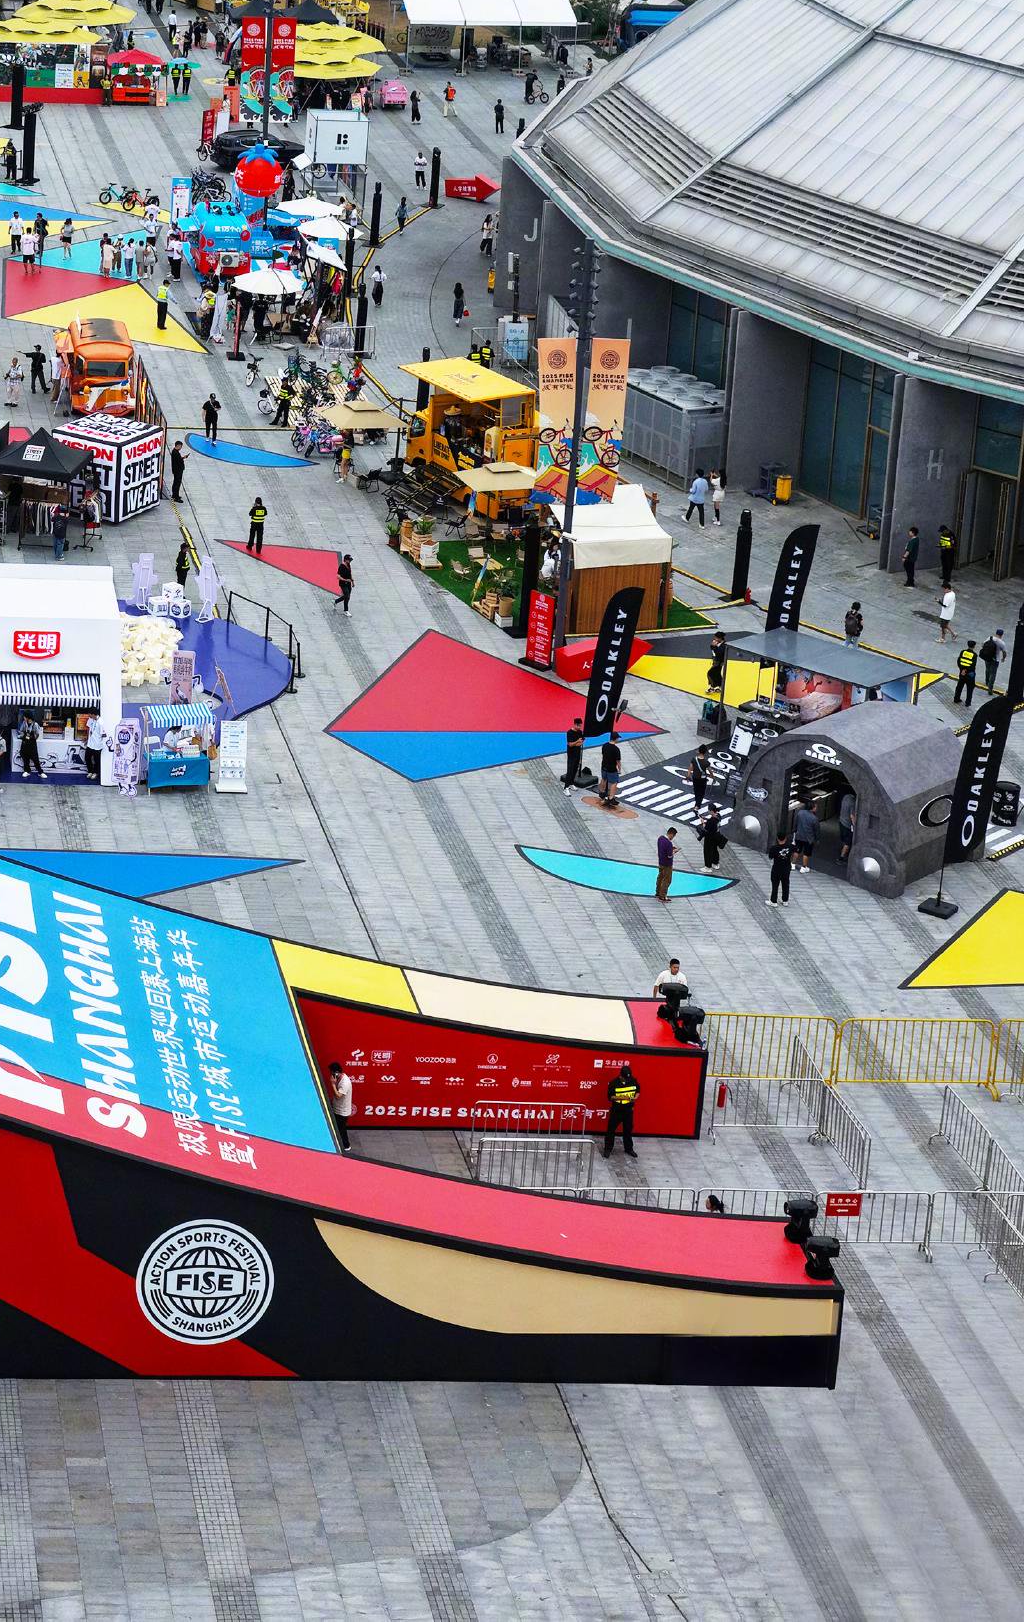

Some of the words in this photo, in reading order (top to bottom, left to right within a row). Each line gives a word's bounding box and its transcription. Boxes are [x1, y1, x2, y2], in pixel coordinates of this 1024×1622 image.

[523, 217, 539, 242] J
[125, 436, 162, 461] VISION
[927, 448, 944, 482] H
[123, 453, 160, 486] STREET
[125, 480, 159, 513] WEAR
[779, 546, 804, 623] OAKLEY
[17, 633, 57, 650] 光明
[601, 608, 628, 692] OAKLEY
[805, 749, 843, 766] OAKLEY
[967, 722, 996, 812] OAKLEY
[52, 890, 147, 1139] SHANGHAI
[129, 915, 212, 1157] 极限运动世界巡回赛上海站
[373, 1051, 391, 1059] 光明
[364, 1104, 408, 1116] 2025
[411, 1106, 452, 1118] FISE
[456, 1107, 555, 1120] SHANGHAI
[561, 1107, 610, 1120] 坡有可
[150, 1244, 177, 1286] ACTION
[177, 1232, 228, 1249] SPORTS
[228, 1238, 261, 1285] FESTIVAL
[176, 1271, 234, 1295] FISE
[172, 1316, 235, 1332] SHANGHAI
